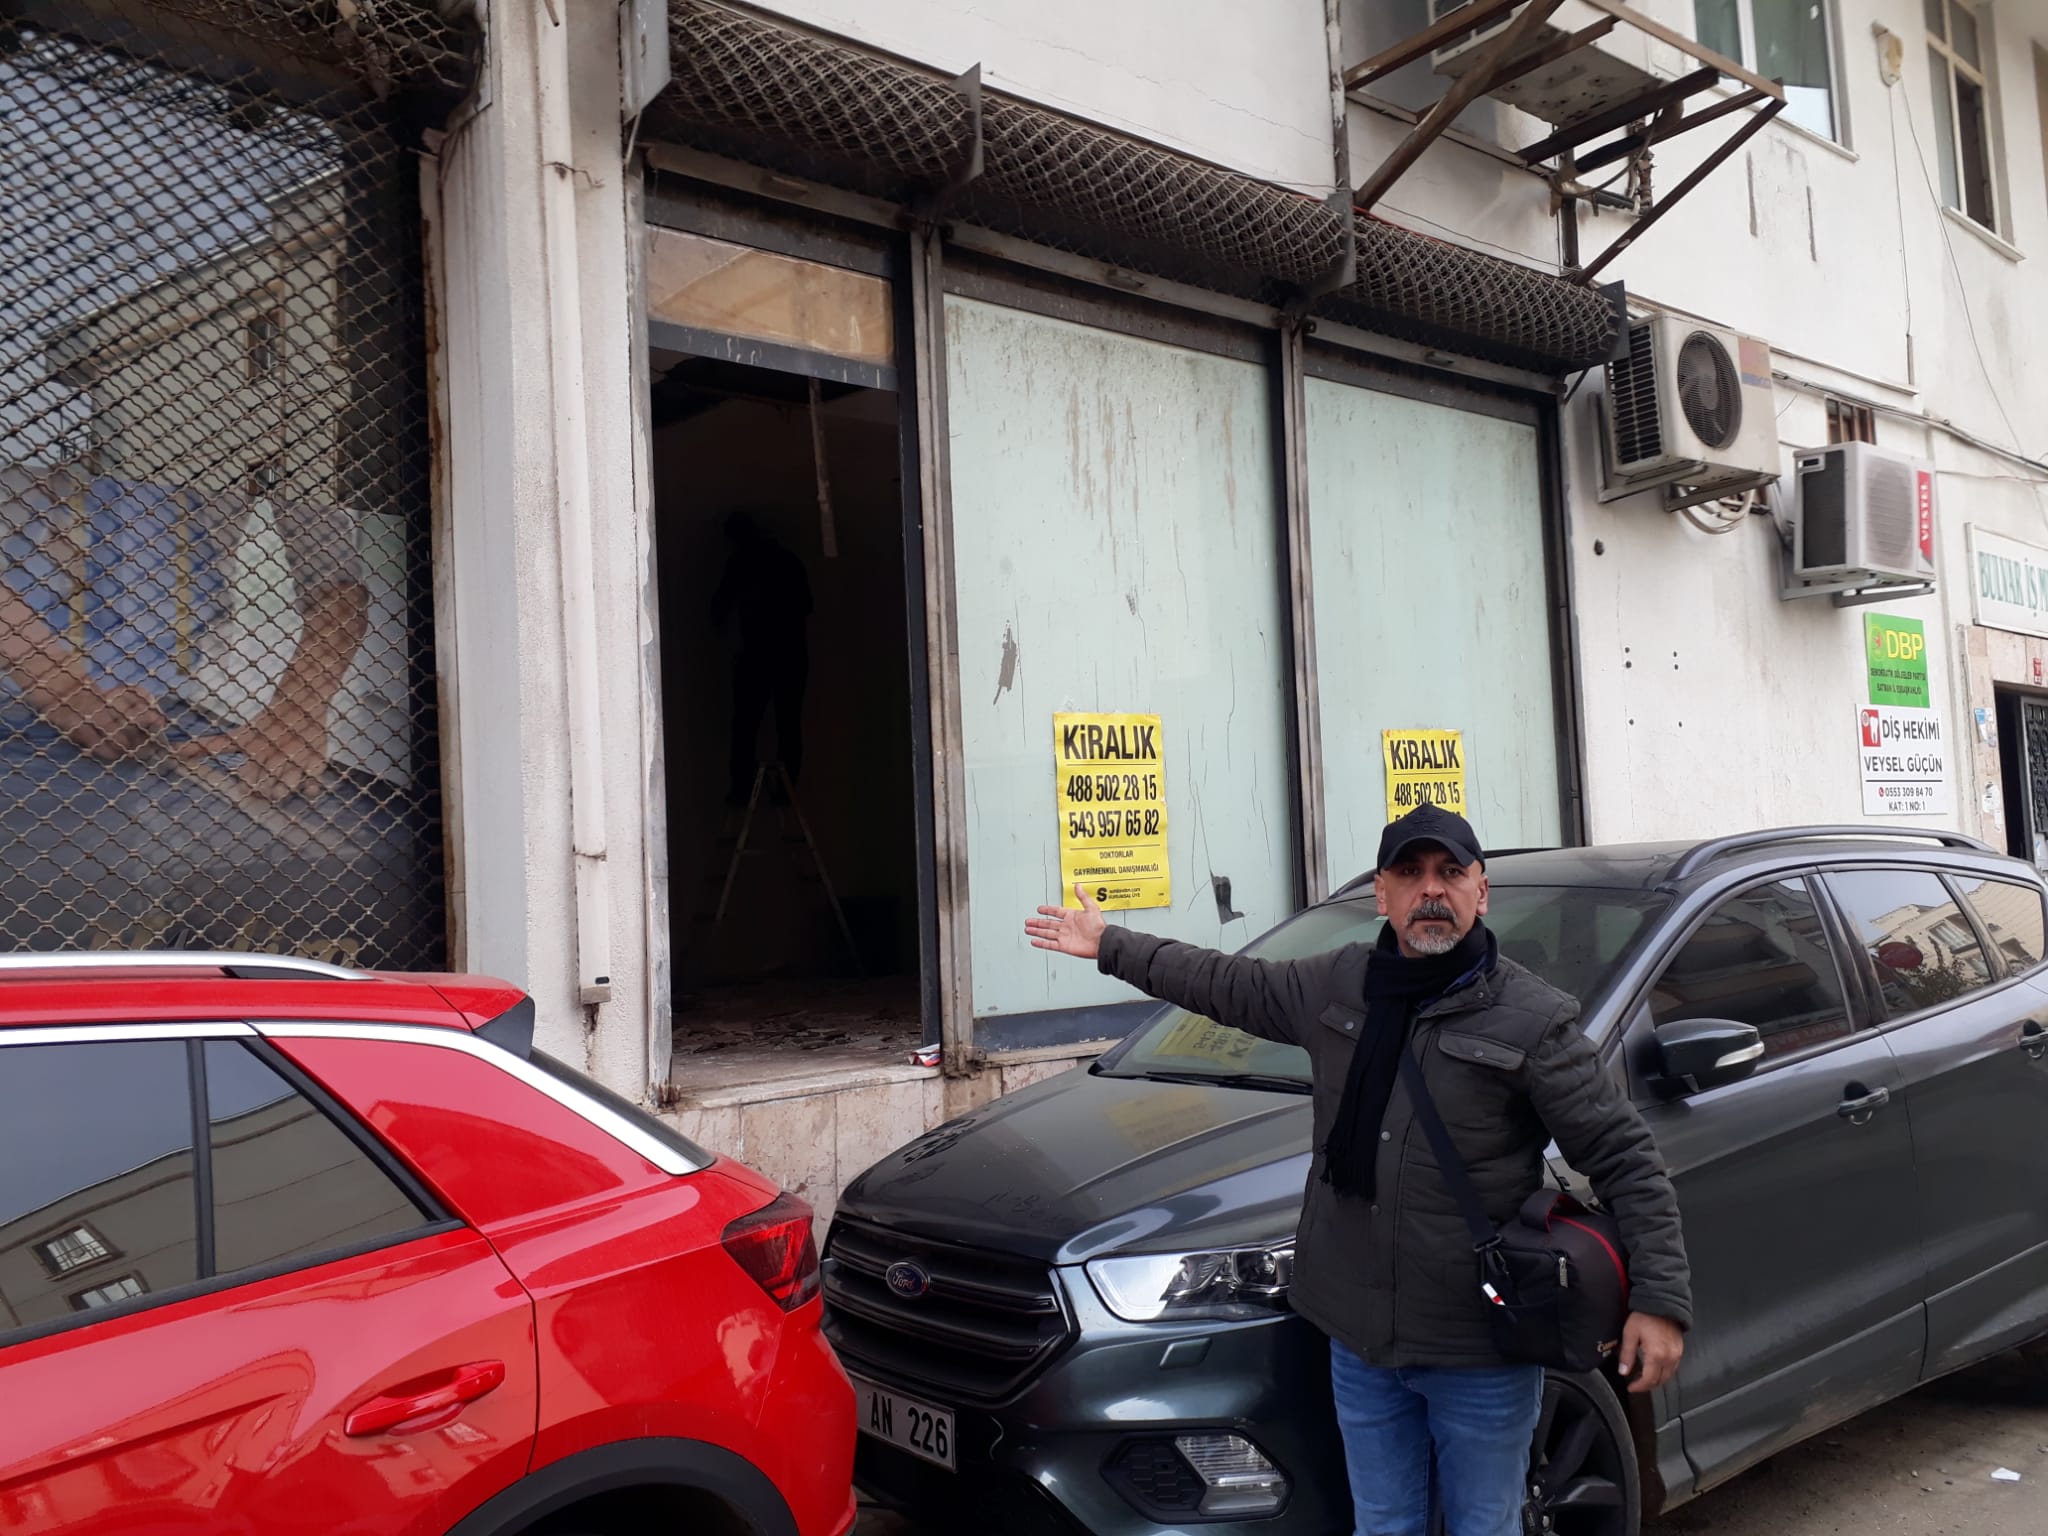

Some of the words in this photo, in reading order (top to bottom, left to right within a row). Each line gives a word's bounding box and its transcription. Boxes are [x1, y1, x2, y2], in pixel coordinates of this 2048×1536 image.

[1885, 629, 1924, 661] DBP
[1882, 715, 1901, 742] DİŞ
[1903, 716, 1940, 740] HEKİMİ
[1864, 756, 1905, 772] VEYSEL
[1907, 753, 1943, 775] GÜÇÜN
[1066, 775, 1092, 802] 488
[1096, 774, 1120, 801] 502
[1124, 774, 1140, 801] 28
[1142, 774, 1157, 801] 15
[1394, 782, 1412, 806] 488
[1413, 782, 1433, 806] 502
[1433, 782, 1447, 805] 28
[1448, 782, 1460, 804] 15
[1885, 787, 1901, 797] 0553
[1902, 787, 1914, 797] 309
[1925, 787, 1933, 797] 70
[1068, 811, 1095, 838] 543
[1098, 810, 1122, 837] 957
[1125, 810, 1140, 836] 65
[1144, 809, 1159, 835] 82
[1099, 850, 1134, 859] DOKTORLAR
[1073, 866, 1117, 876] GAYRİMENKUL
[1119, 862, 1159, 875] DANIŞMANLIĞI
[1096, 887, 1108, 902] S
[870, 1391, 893, 1438] AN
[908, 1406, 948, 1459] 226
